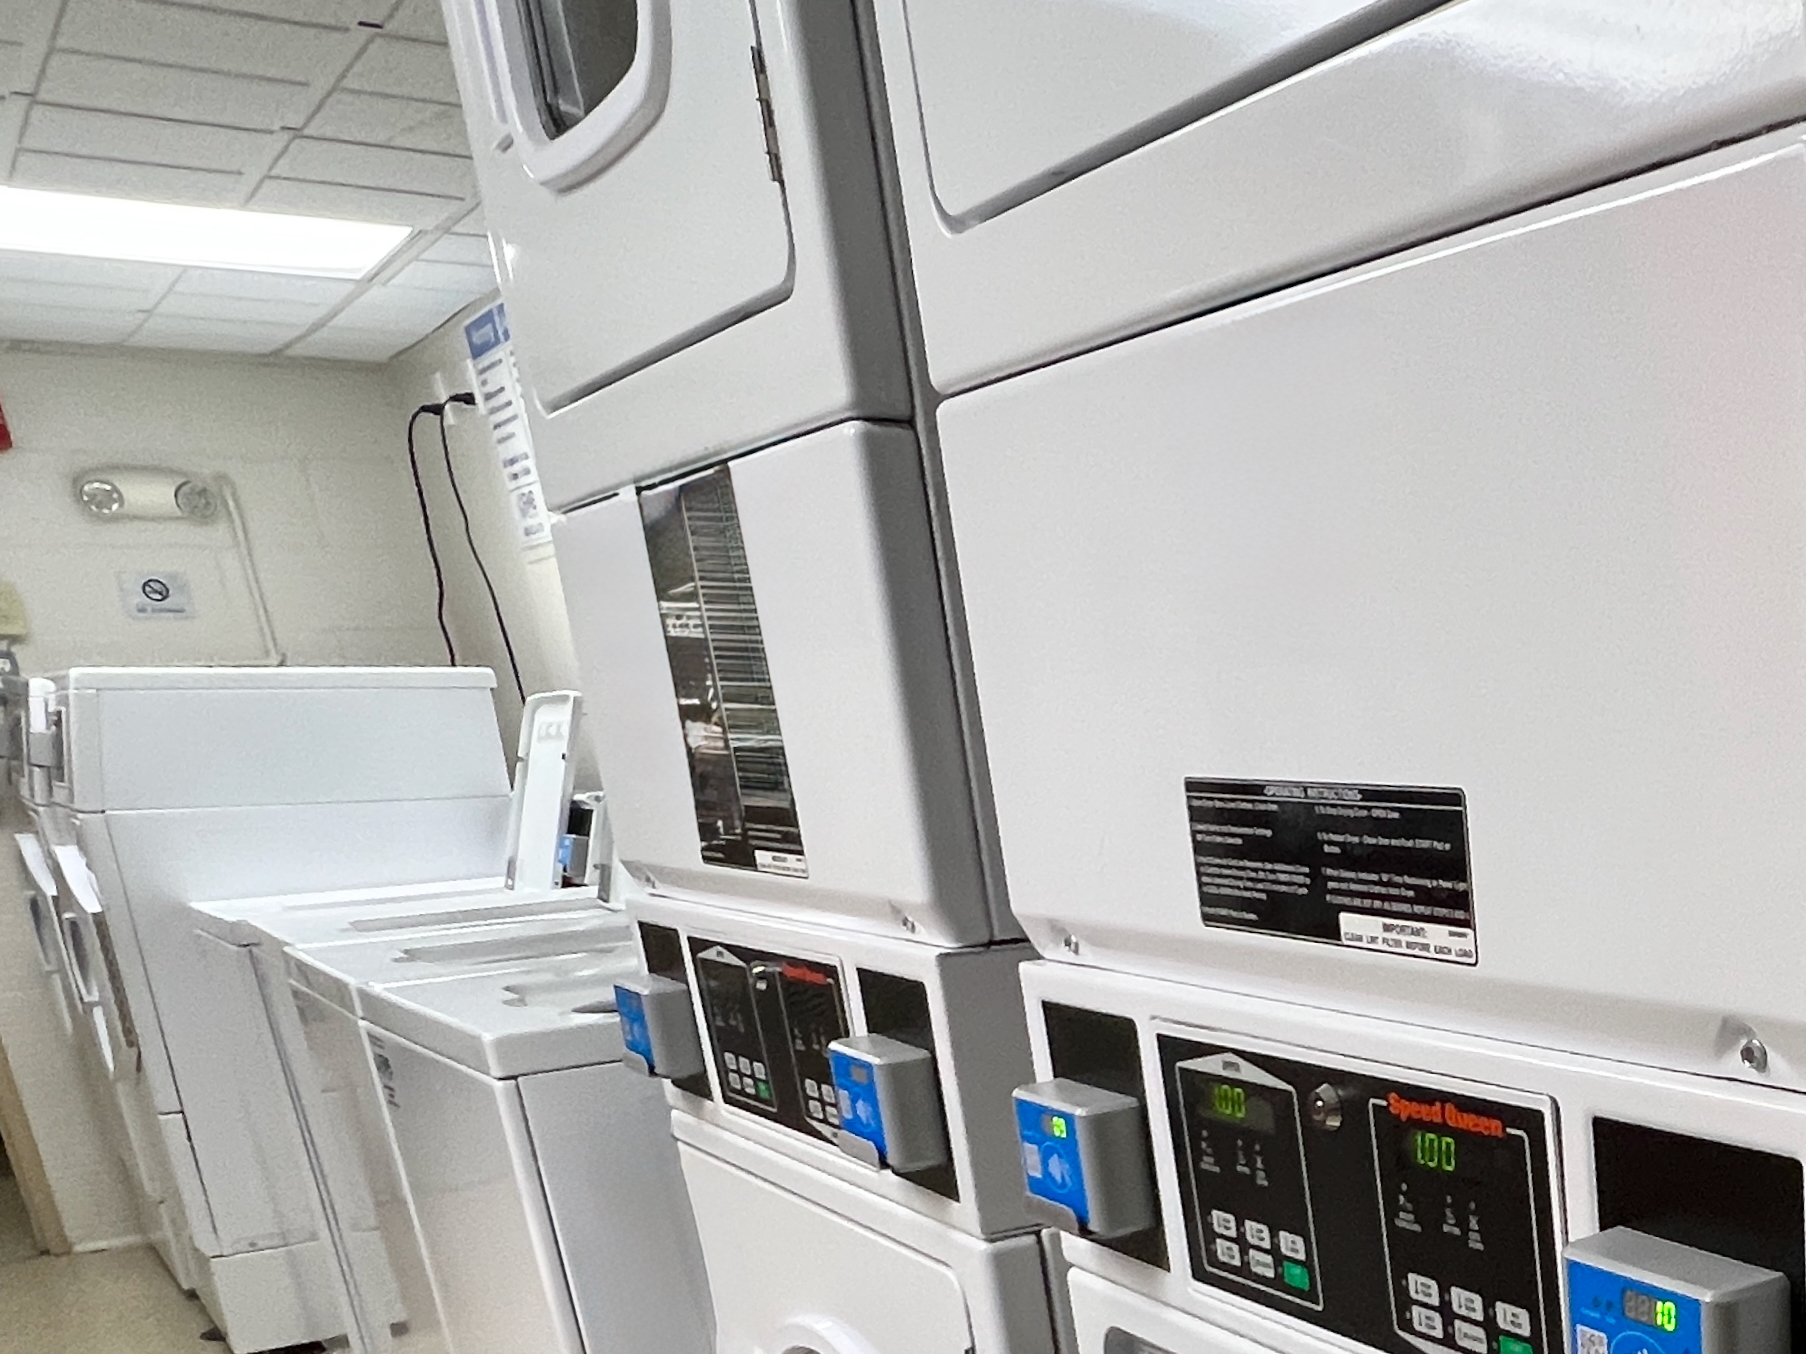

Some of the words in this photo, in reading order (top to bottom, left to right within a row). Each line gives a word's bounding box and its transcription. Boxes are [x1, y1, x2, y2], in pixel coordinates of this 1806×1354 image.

[1388, 1092, 1443, 1122] Speed
[1445, 1102, 1505, 1138] Queen
[1656, 1300, 1676, 1332] 10
